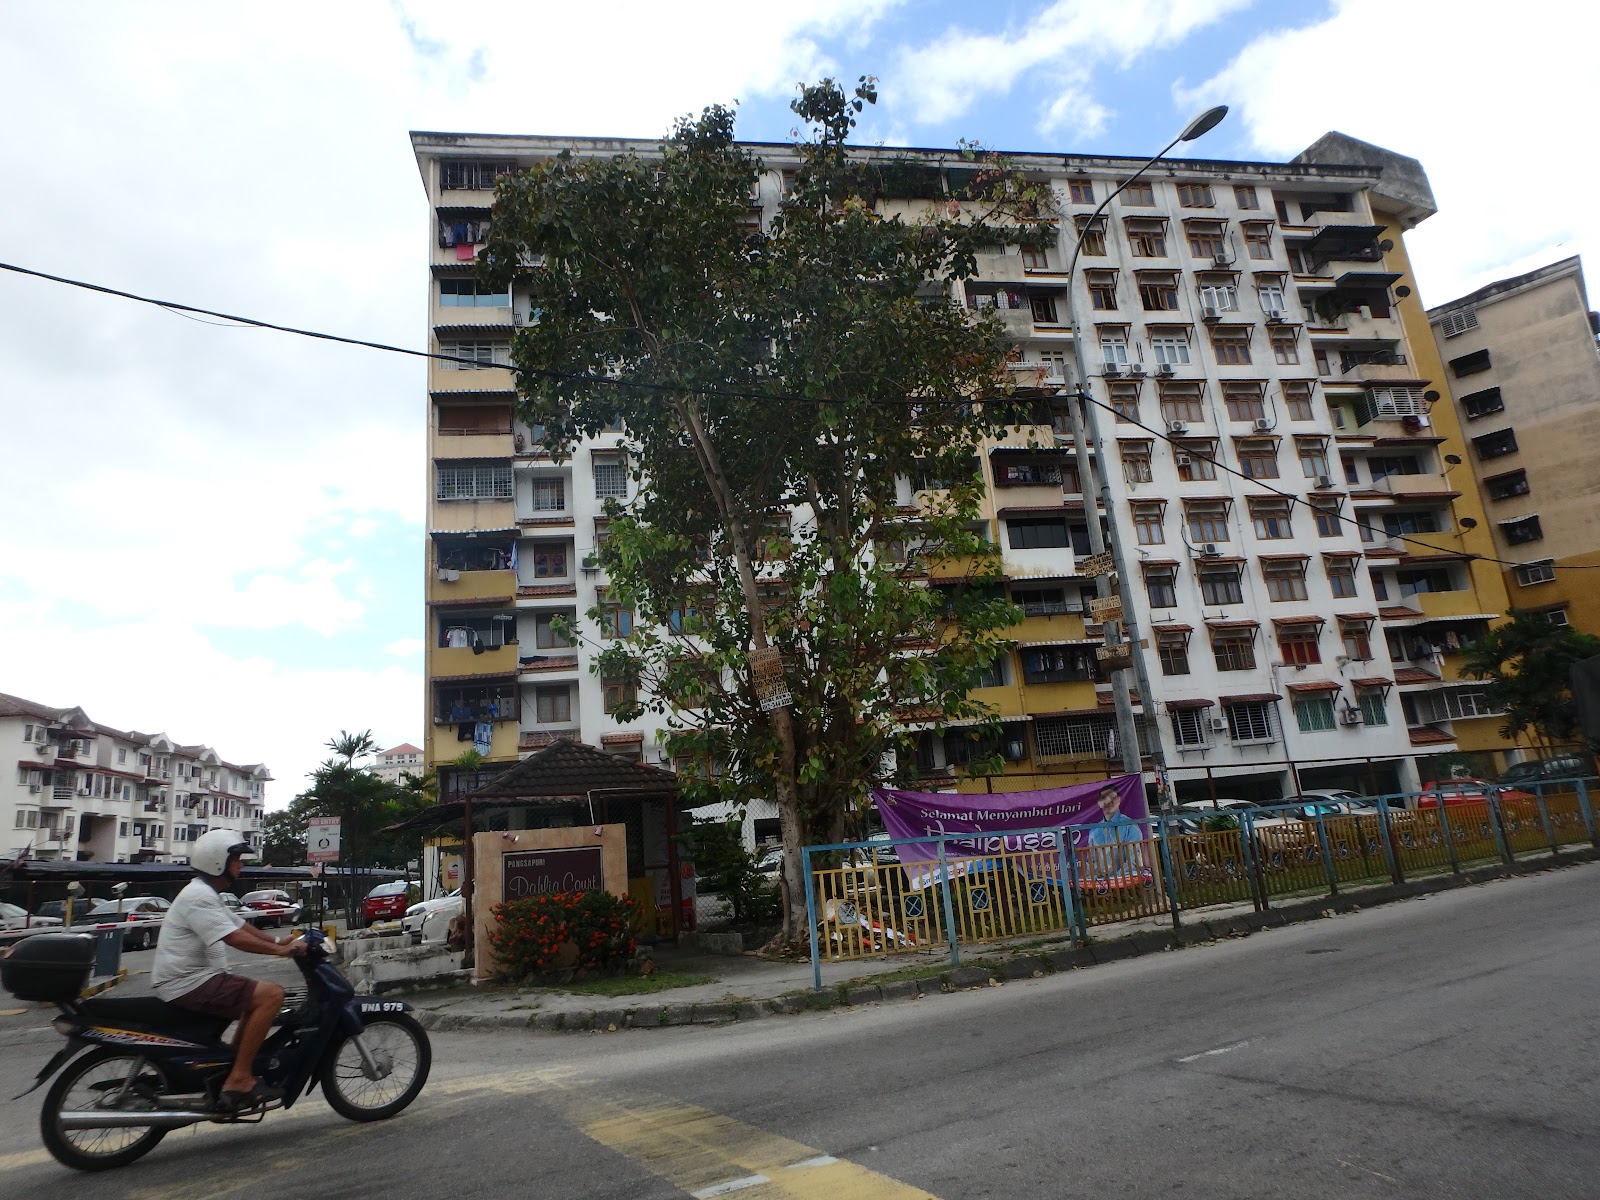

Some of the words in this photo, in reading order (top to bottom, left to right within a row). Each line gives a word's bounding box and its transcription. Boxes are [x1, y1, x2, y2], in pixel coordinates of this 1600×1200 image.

[920, 809, 974, 821] Selamat
[976, 806, 1053, 822] Menyambut
[1056, 802, 1082, 815] Hari
[507, 858, 546, 869] PANGSAPURI
[508, 874, 560, 897] Dahlia
[562, 871, 597, 893] Court
[382, 1002, 404, 1012] 975
